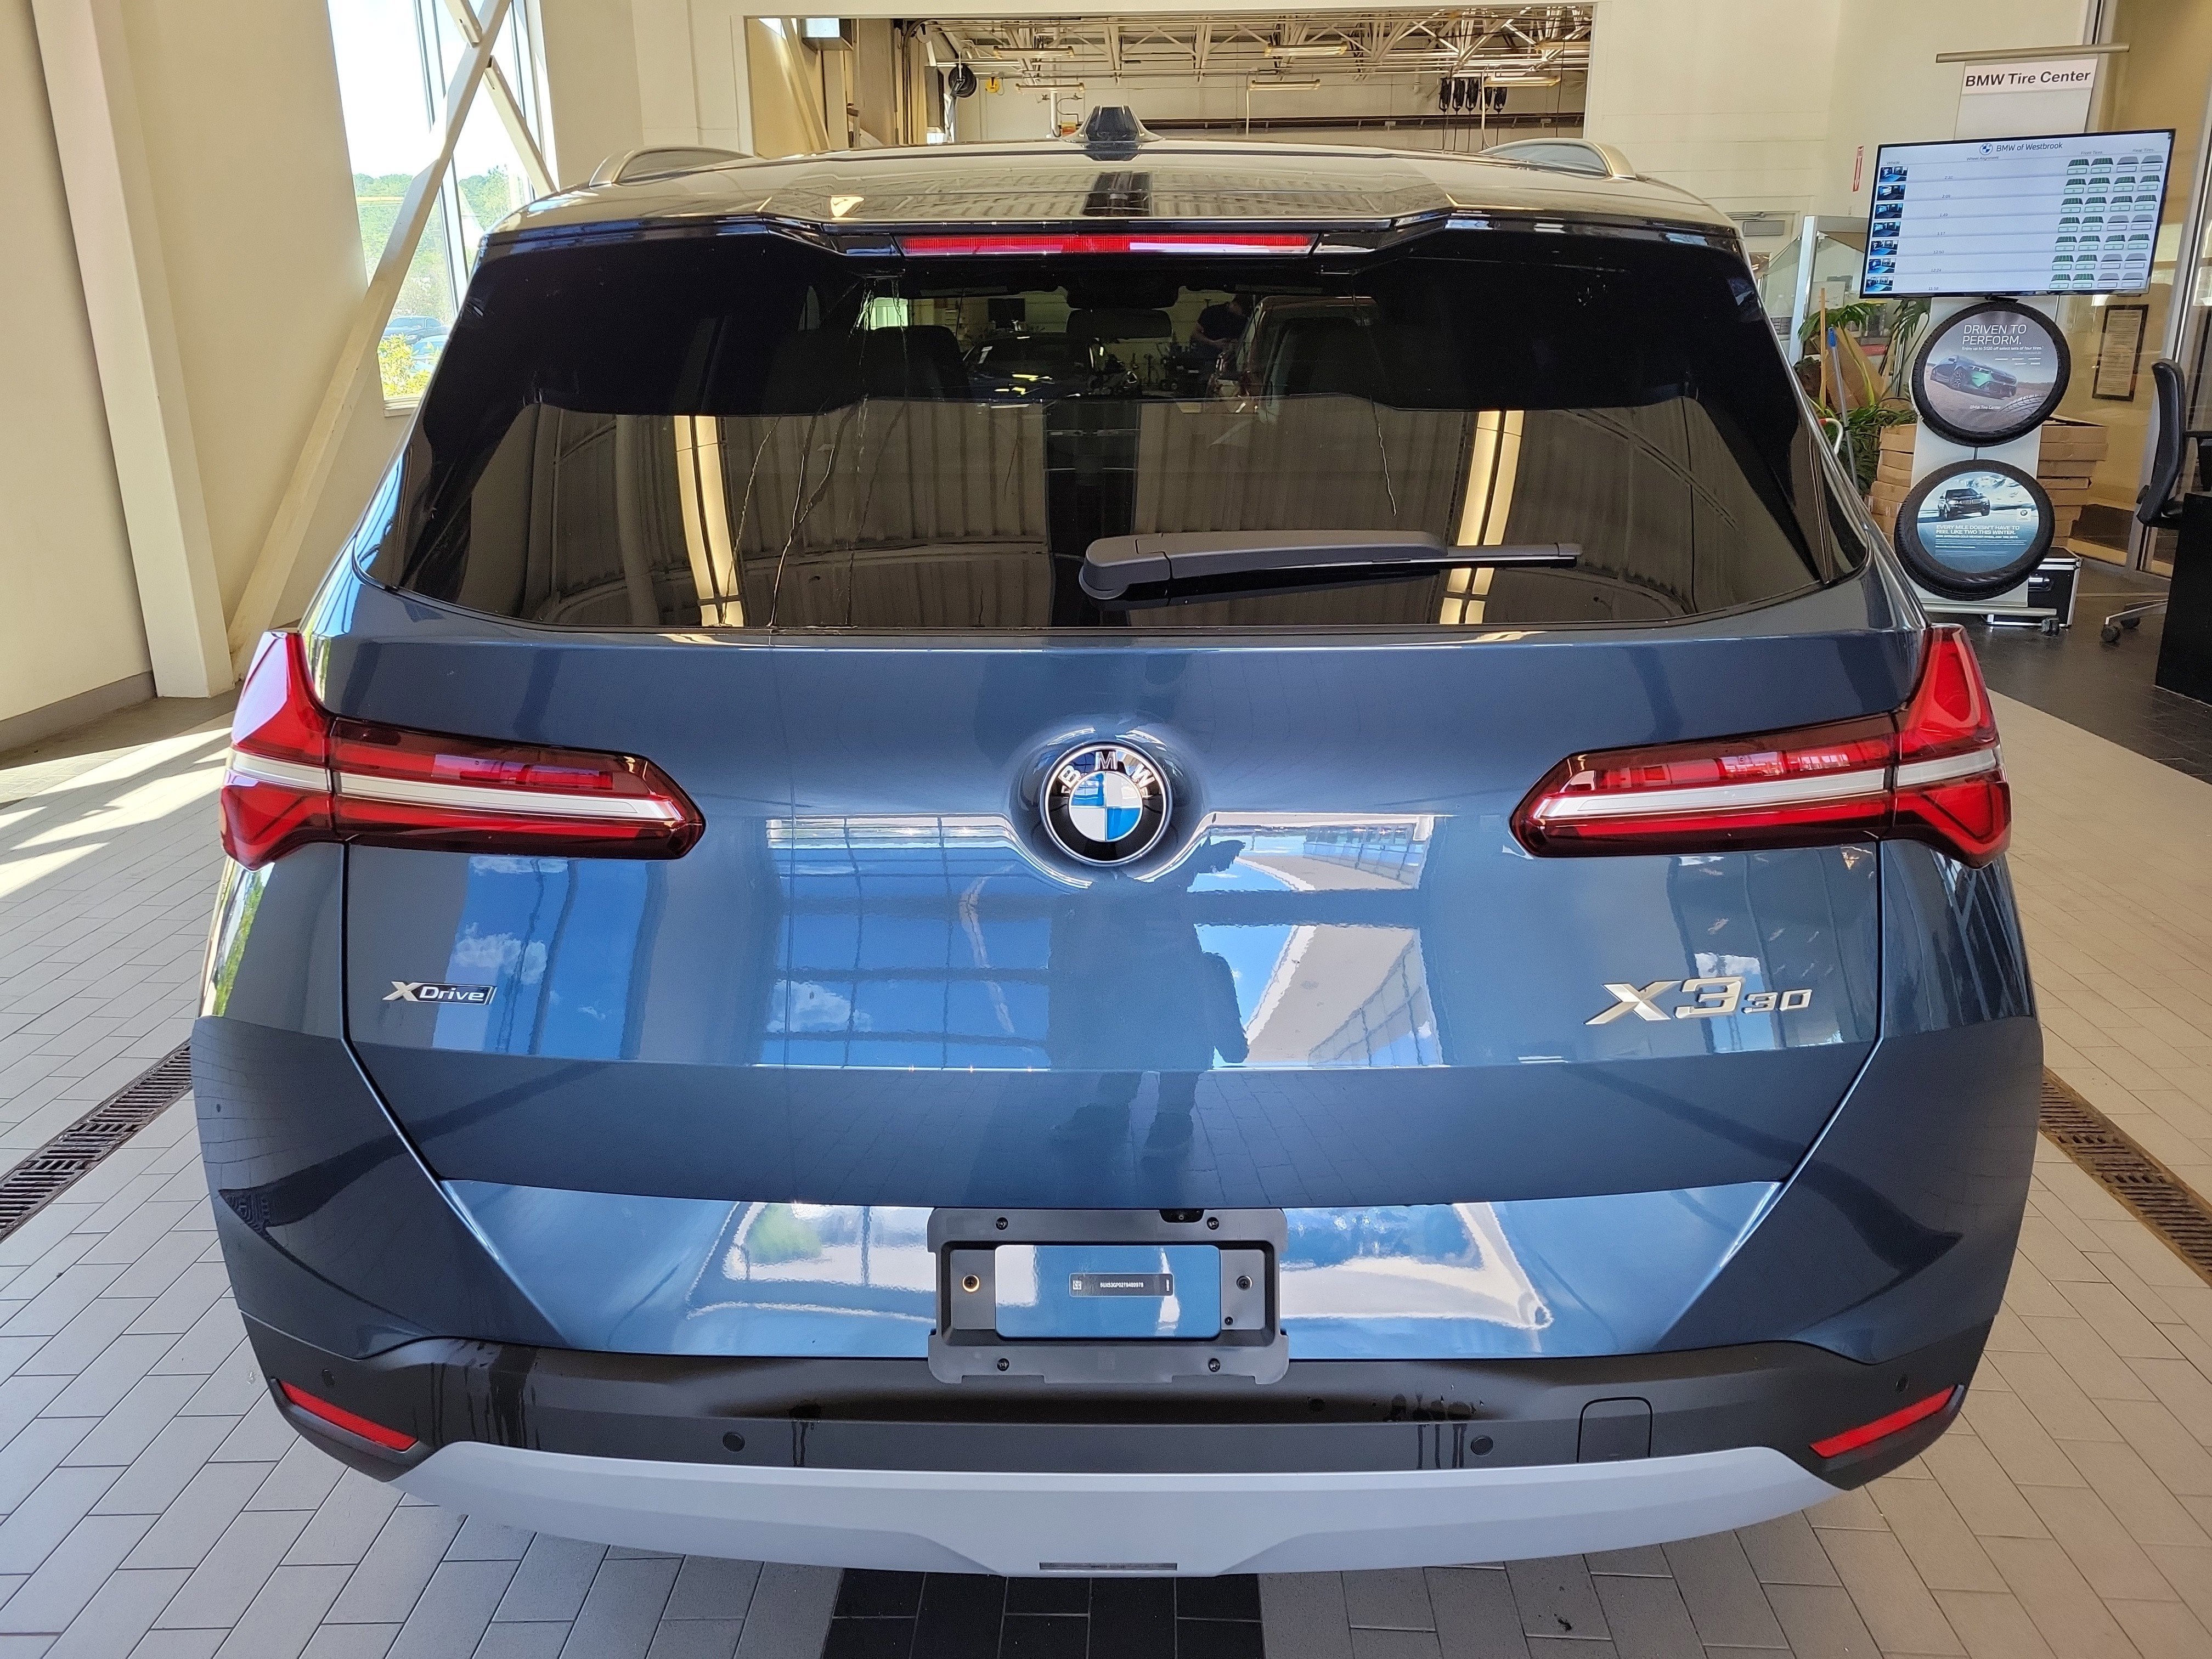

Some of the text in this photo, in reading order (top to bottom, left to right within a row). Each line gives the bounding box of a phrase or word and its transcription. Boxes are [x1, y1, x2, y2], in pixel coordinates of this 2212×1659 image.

[1966, 71, 2091, 87] BMW Tire Center
[1963, 324, 2027, 334] DRIVEN TO
[1962, 335, 2022, 345] PERFORM.
[1058, 751, 1155, 790] BMW
